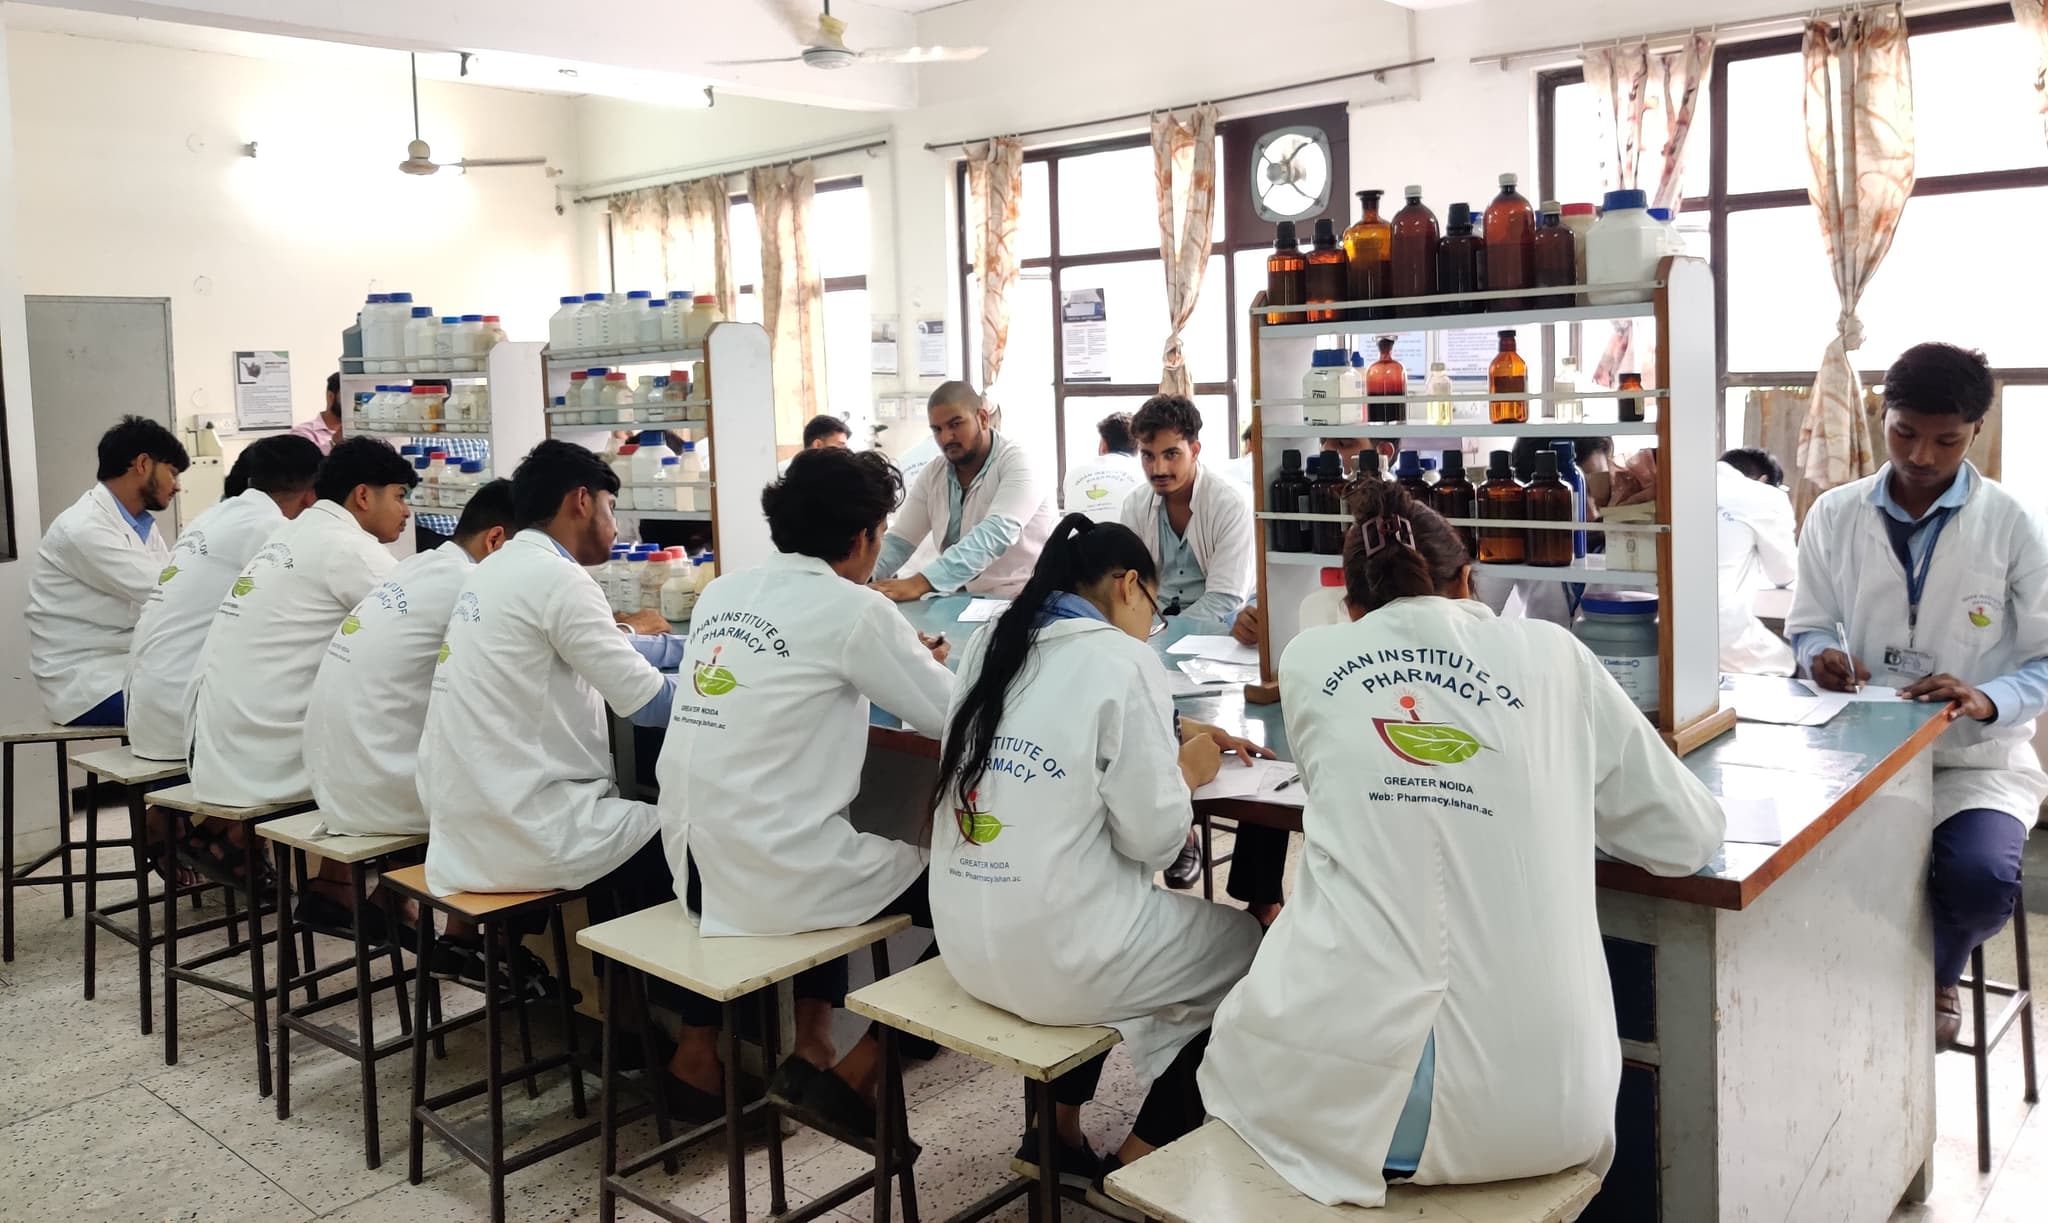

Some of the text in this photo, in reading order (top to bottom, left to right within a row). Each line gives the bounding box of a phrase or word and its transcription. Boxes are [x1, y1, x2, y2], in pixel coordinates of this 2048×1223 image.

[398, 600, 408, 615] OF
[701, 626, 767, 655] PHARMACY
[720, 611, 779, 639] INSTITUTE
[773, 638, 790, 659] OF
[1322, 648, 1525, 711] ISHAN INSTITUTE OF
[1361, 668, 1492, 707] PHARMACY
[986, 757, 1037, 783] RMACY
[993, 736, 1067, 779] TITUTE OF
[1368, 791, 1395, 802] Web:
[1384, 776, 1475, 795] GREATER NOIDA
[960, 857, 1010, 869] GREATER NOIDA
